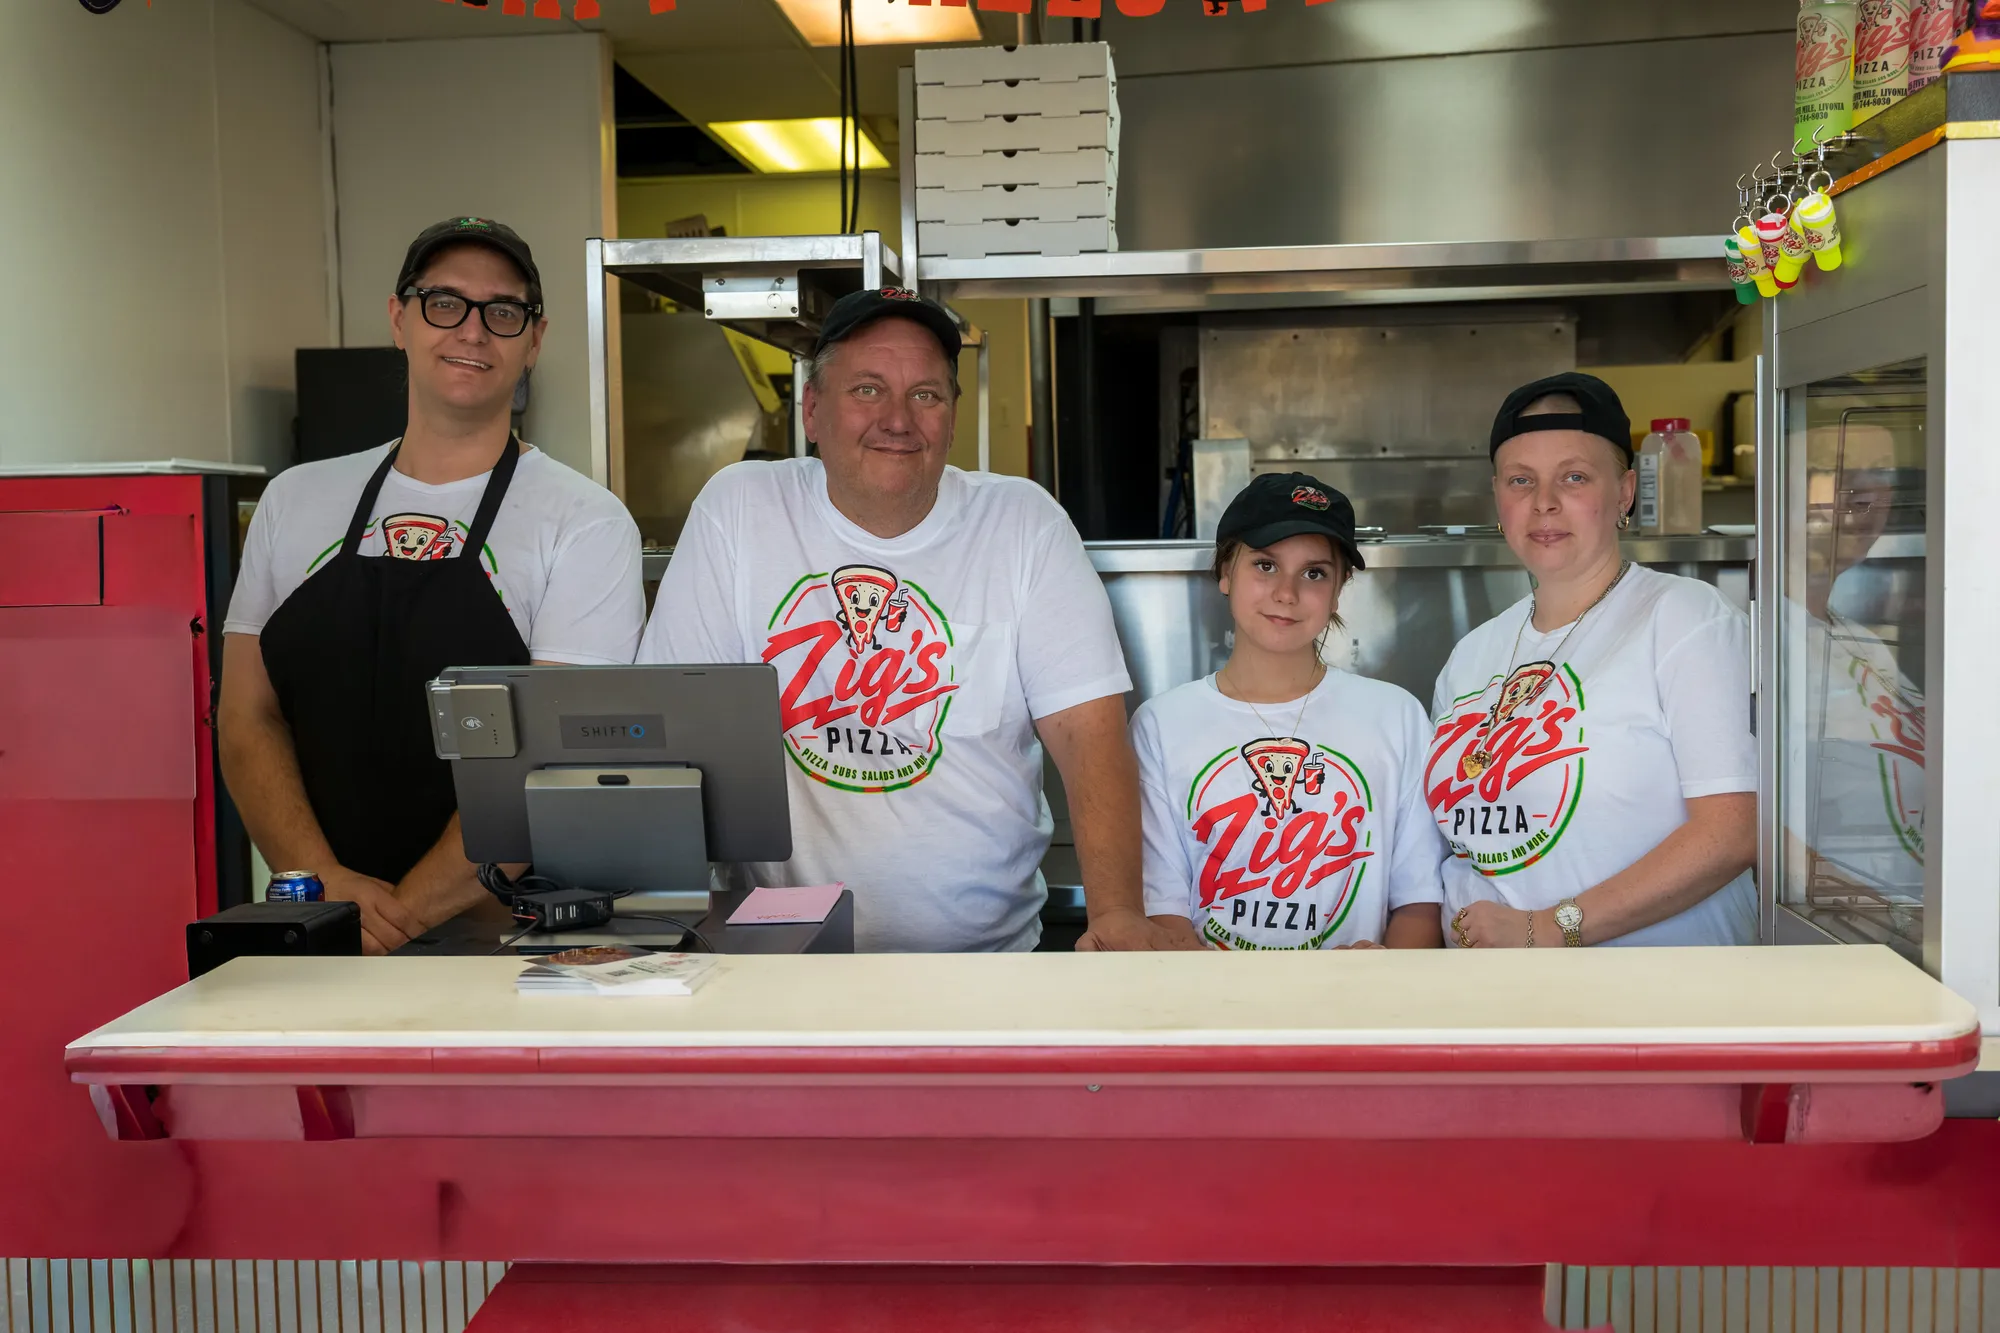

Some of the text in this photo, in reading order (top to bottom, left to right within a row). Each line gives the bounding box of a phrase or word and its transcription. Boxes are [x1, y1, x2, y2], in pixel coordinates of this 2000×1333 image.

[1913, 46, 1944, 62] PIZZ
[1818, 102, 1844, 111] LIVONIA
[1880, 88, 1908, 97] LIVONIA
[761, 620, 960, 734] Zig's
[826, 727, 913, 755] PIZZA
[1423, 700, 1590, 814] Zig's
[801, 747, 828, 771] PIZZA
[832, 764, 857, 780] SUBS
[861, 768, 895, 782] SALADS
[897, 765, 914, 778] AND
[1453, 805, 1529, 836] PIZZA
[1191, 791, 1375, 908] Zig's
[1477, 851, 1509, 864] SALADS
[1511, 845, 1527, 860] AND
[1525, 828, 1550, 851] MORE
[1231, 898, 1317, 931] PIZZA
[1207, 917, 1231, 941] PIZZA
[1234, 936, 1258, 950] SUBS
